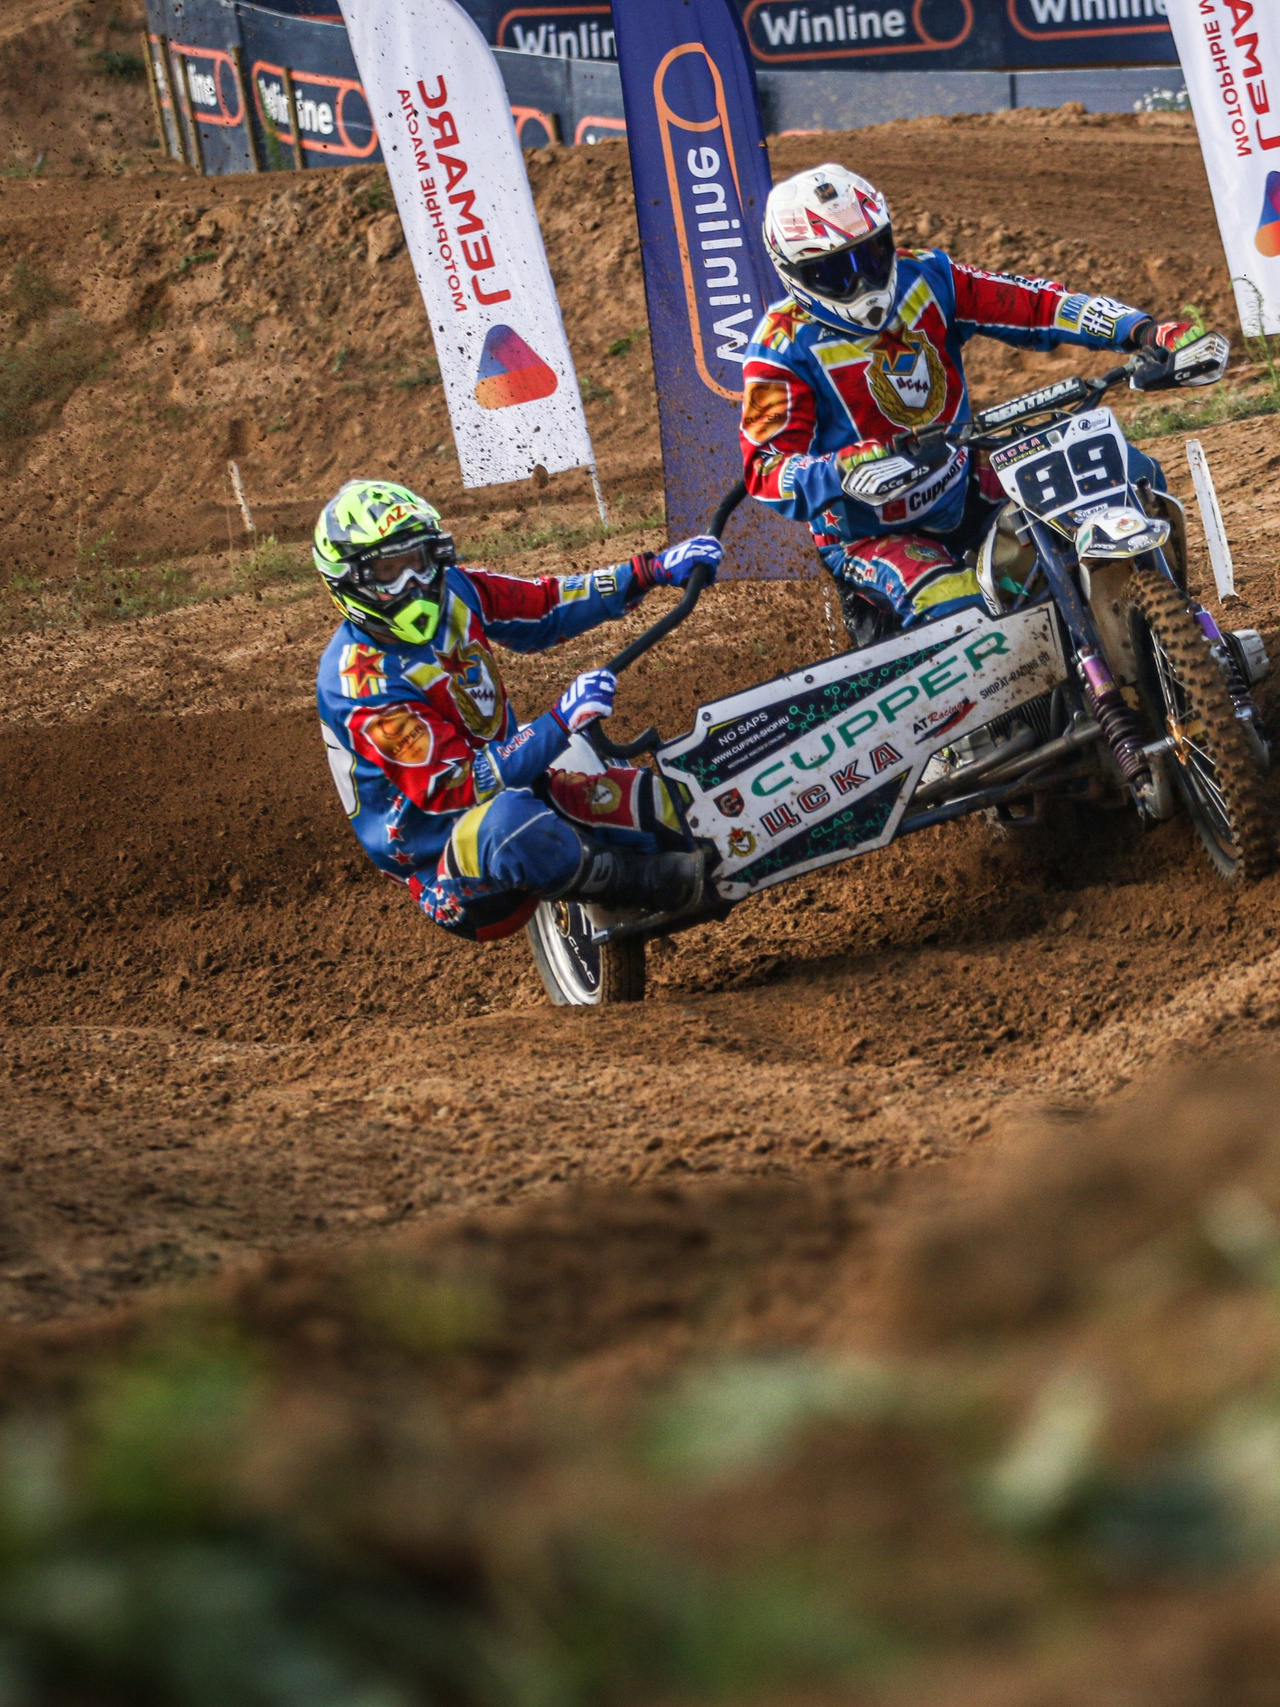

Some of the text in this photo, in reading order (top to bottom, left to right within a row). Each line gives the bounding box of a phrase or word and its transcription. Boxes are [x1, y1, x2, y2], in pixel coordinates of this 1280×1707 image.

[512, 21, 617, 59] Winlin
[760, 5, 906, 46] Winline
[257, 77, 334, 135] Winine
[985, 378, 1080, 423] RENTHAL
[1014, 433, 1127, 517] 89
[718, 712, 768, 746] NO SAPS
[751, 631, 1012, 797] CUPPER
[760, 741, 904, 837] ЦСКА
[810, 810, 855, 839] CLAD
